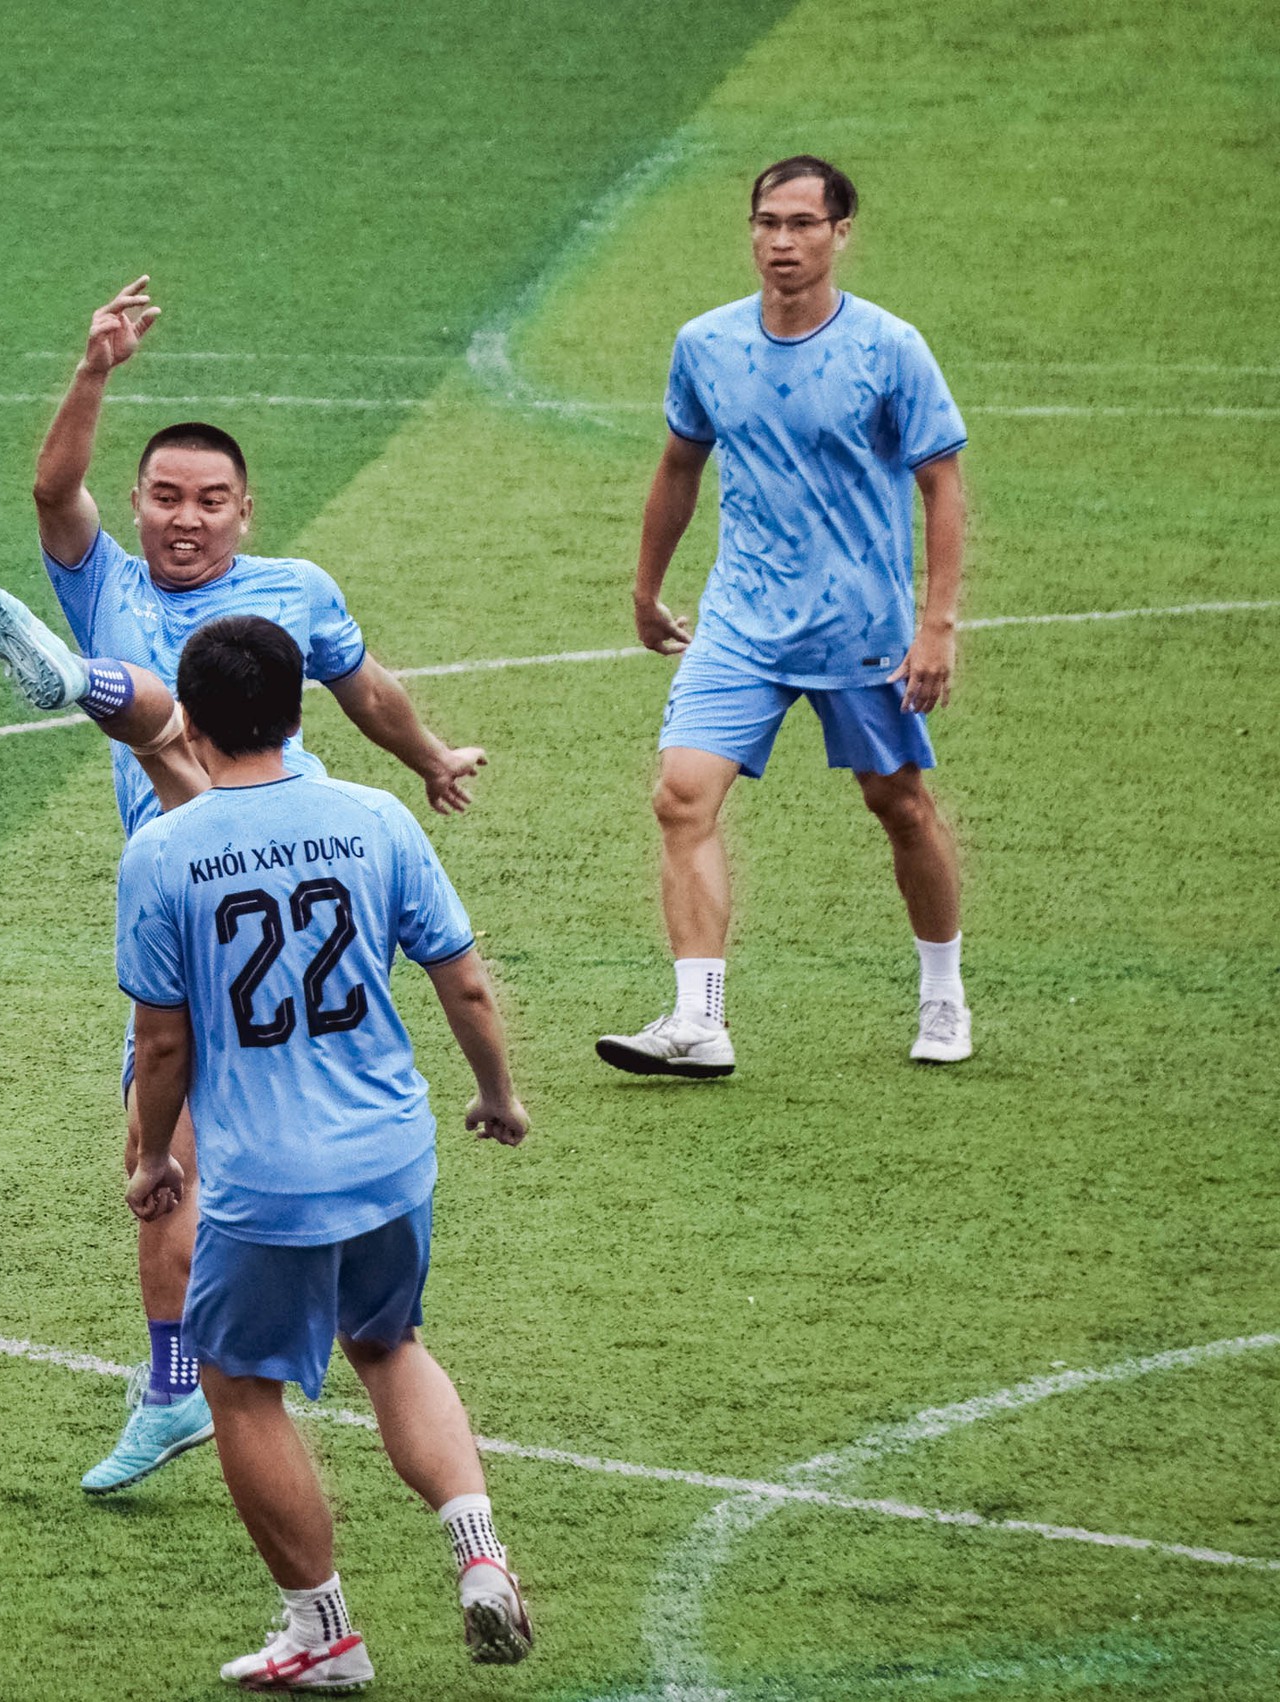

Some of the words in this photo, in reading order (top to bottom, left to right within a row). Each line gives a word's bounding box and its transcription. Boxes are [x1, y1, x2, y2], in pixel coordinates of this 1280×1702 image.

[189, 842, 247, 884] KHỐI
[252, 840, 297, 871] XÂY
[304, 836, 365, 866] DỰNG
[215, 877, 369, 1048] 22
